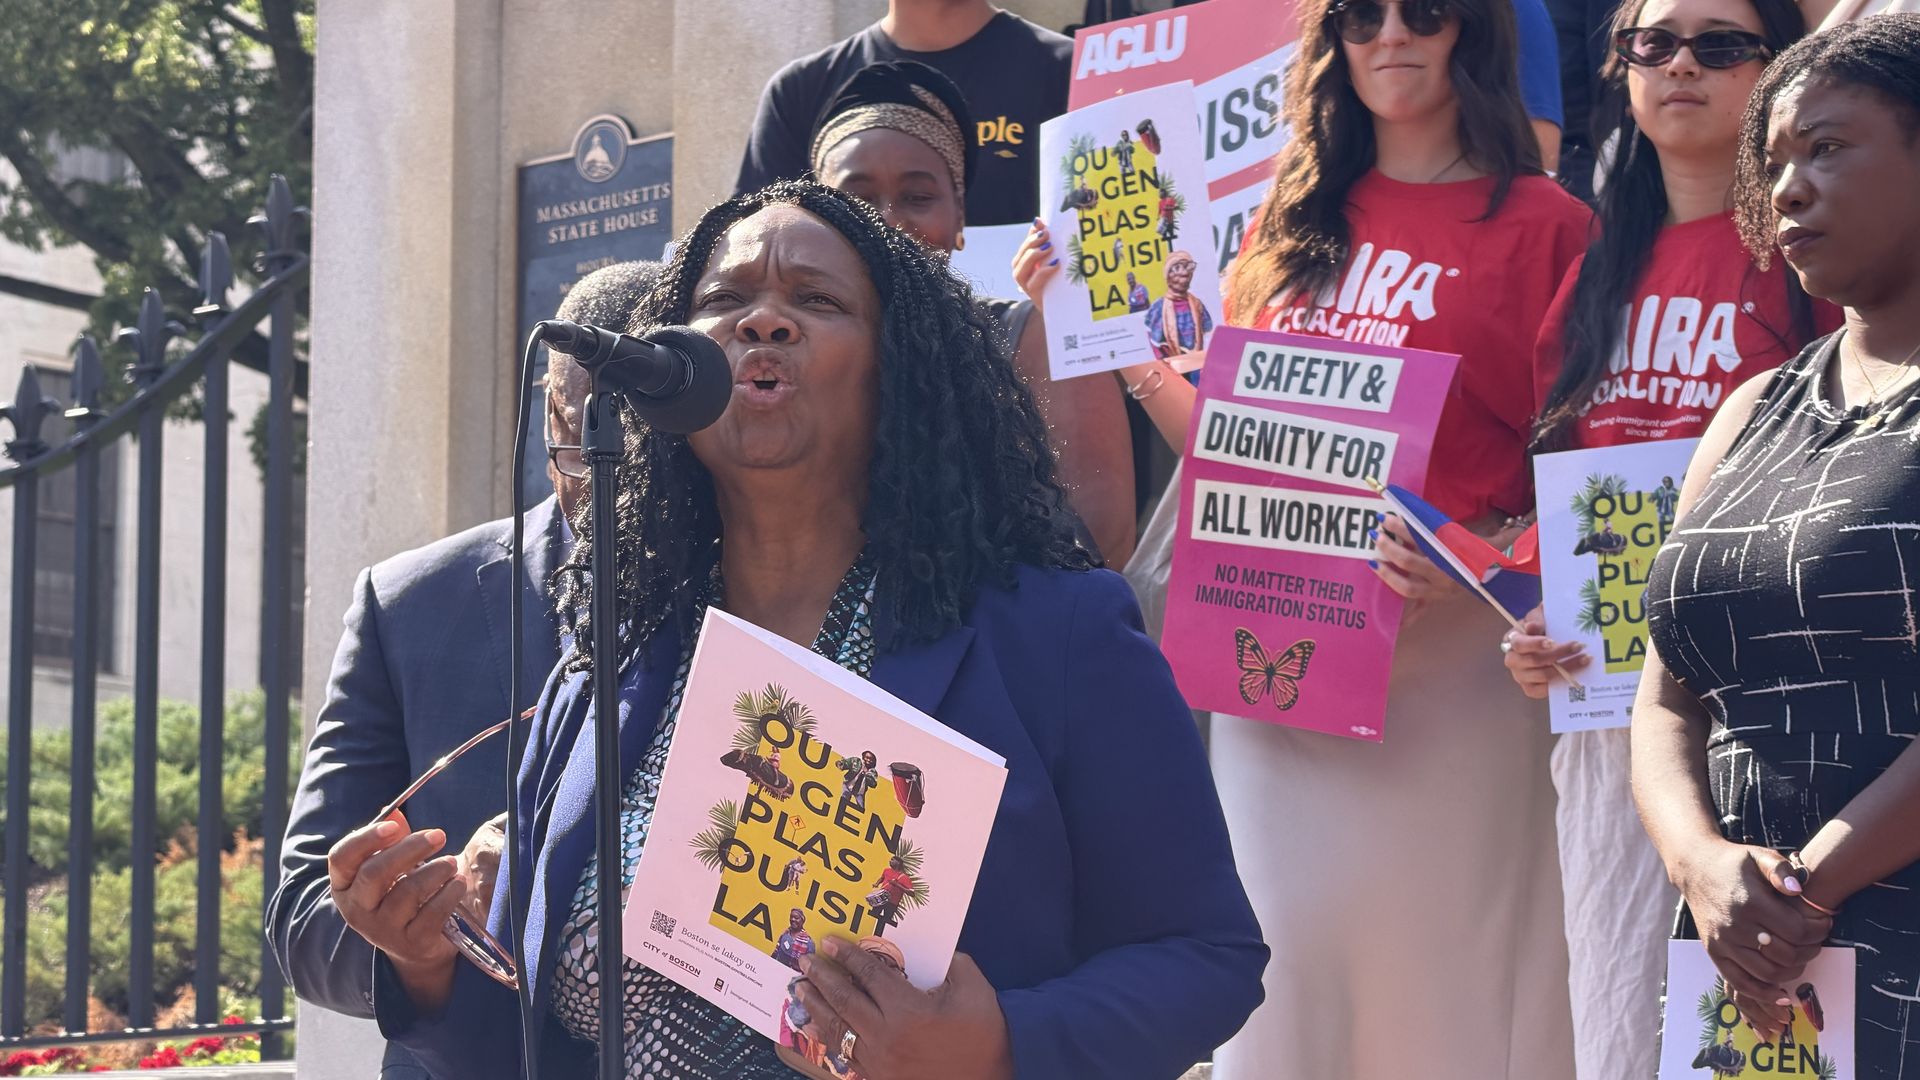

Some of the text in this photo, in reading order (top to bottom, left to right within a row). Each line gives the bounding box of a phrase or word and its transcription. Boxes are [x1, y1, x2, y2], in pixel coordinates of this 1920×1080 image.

[1076, 15, 1187, 80] ACLU
[976, 115, 1024, 146] ple
[1197, 74, 1279, 161] ISS
[1072, 146, 1108, 176] OU
[537, 182, 671, 223] MASSACHUSETTS
[1101, 166, 1159, 200] GEN
[548, 208, 658, 244] STATE HOUSE
[1079, 205, 1150, 242] PLAS
[1080, 249, 1120, 279] OU
[1268, 242, 1442, 321] IRA
[1089, 284, 1128, 313] LA
[1244, 350, 1388, 403] SAFETY &
[1204, 411, 1387, 482] DIGNITY FOR
[1200, 491, 1397, 551] ALL WORKER
[1590, 490, 1643, 519] OU
[1215, 563, 1354, 603] NO MATTER THEIR
[1195, 584, 1366, 630] IMMIGRATION STATUS
[1604, 635, 1647, 663] LA
[759, 713, 832, 770] OU
[740, 793, 865, 882] PLAS
[800, 781, 902, 854] GEN
[719, 838, 788, 892] OU
[712, 883, 773, 941] LA
[643, 941, 660, 954] CITY
[669, 954, 701, 976] BOSTON
[681, 927, 710, 947] Boston
[711, 943, 721, 953] se
[721, 947, 744, 968] lakay
[1751, 1042, 1820, 1075] GEN
